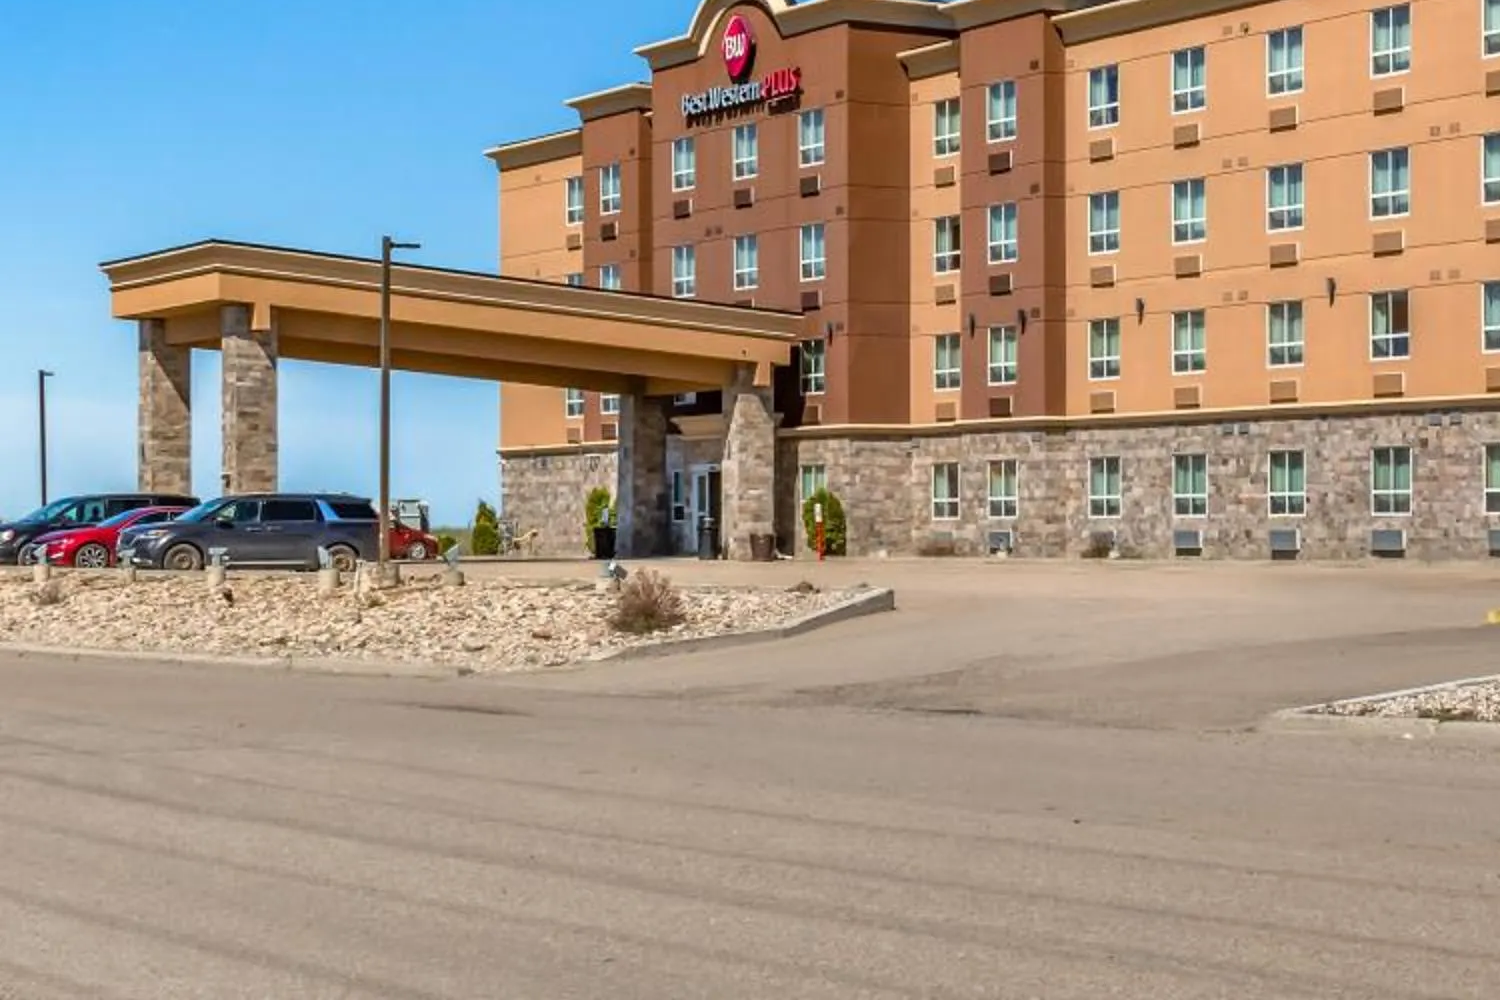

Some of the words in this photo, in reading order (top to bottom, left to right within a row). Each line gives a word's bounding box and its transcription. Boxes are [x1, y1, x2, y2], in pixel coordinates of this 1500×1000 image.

[725, 33, 746, 60] BW
[681, 93, 708, 116] Best
[708, 83, 761, 109] Western
[761, 68, 799, 97] PLUS
